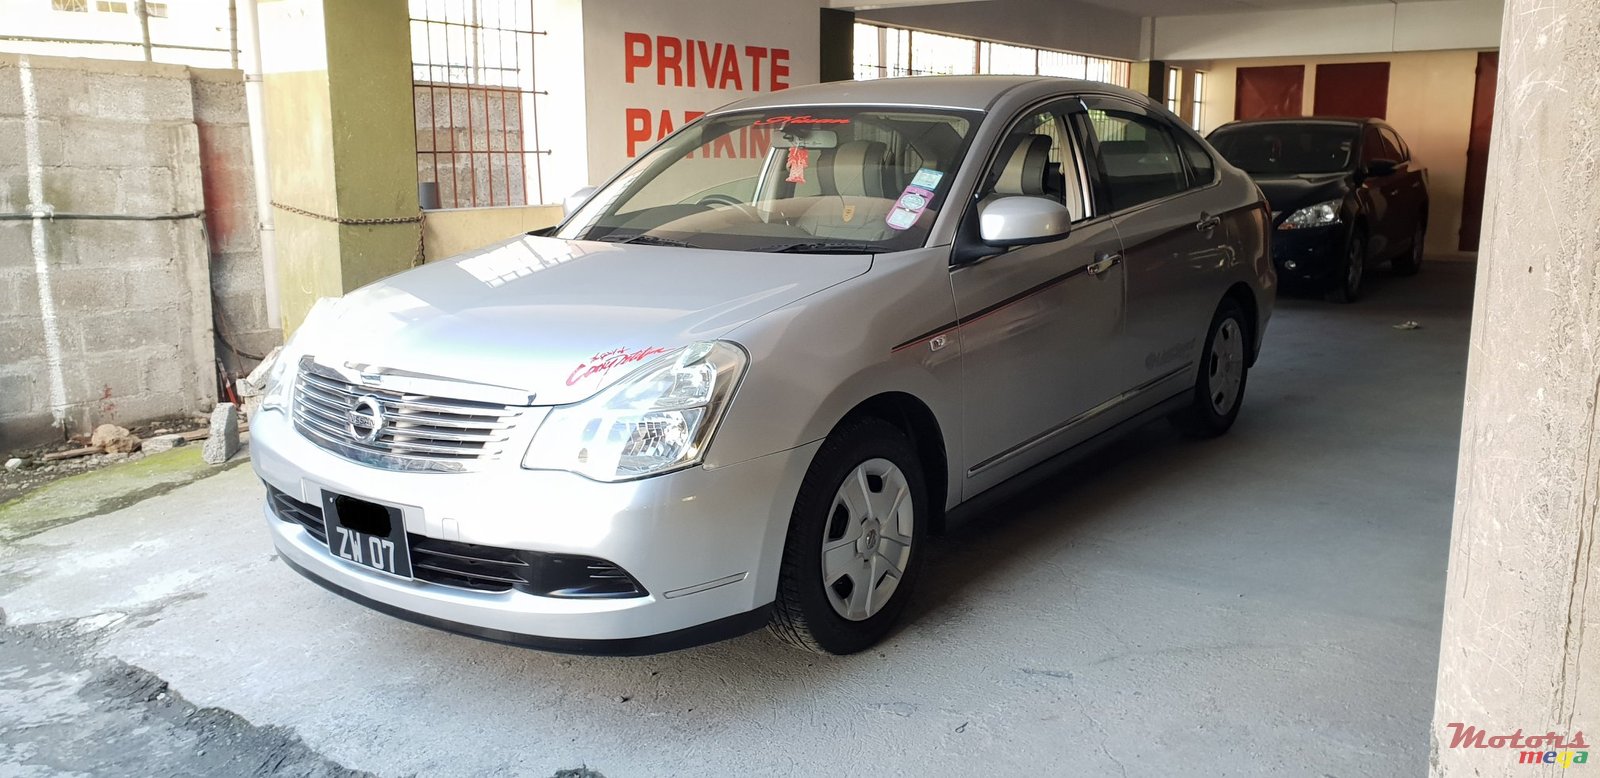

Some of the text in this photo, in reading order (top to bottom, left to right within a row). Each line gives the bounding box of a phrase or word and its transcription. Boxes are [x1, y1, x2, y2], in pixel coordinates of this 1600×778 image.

[624, 31, 790, 92] PRIVATE
[625, 108, 771, 159] PAKIN
[336, 526, 395, 573] ZW 07
